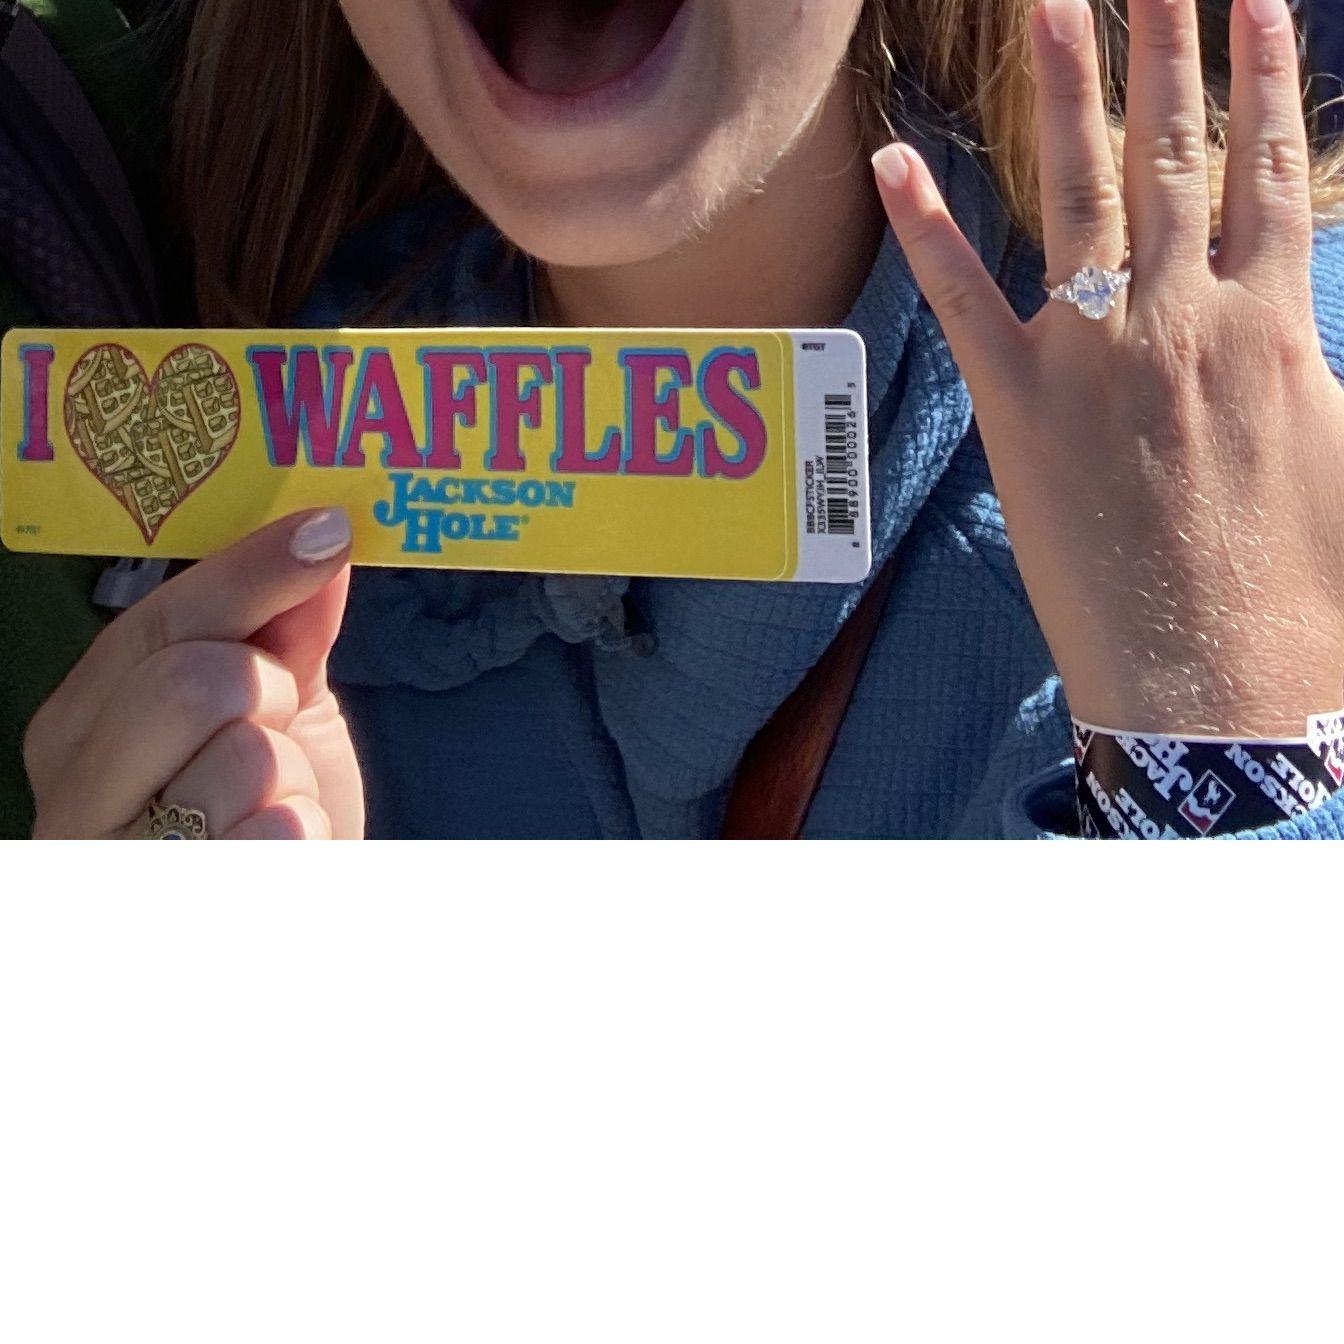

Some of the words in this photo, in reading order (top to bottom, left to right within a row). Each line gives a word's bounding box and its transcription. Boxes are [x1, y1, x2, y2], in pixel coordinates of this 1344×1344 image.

[17, 343, 55, 462] I
[245, 343, 769, 480] WAFFLES
[373, 471, 577, 528] JACKSON
